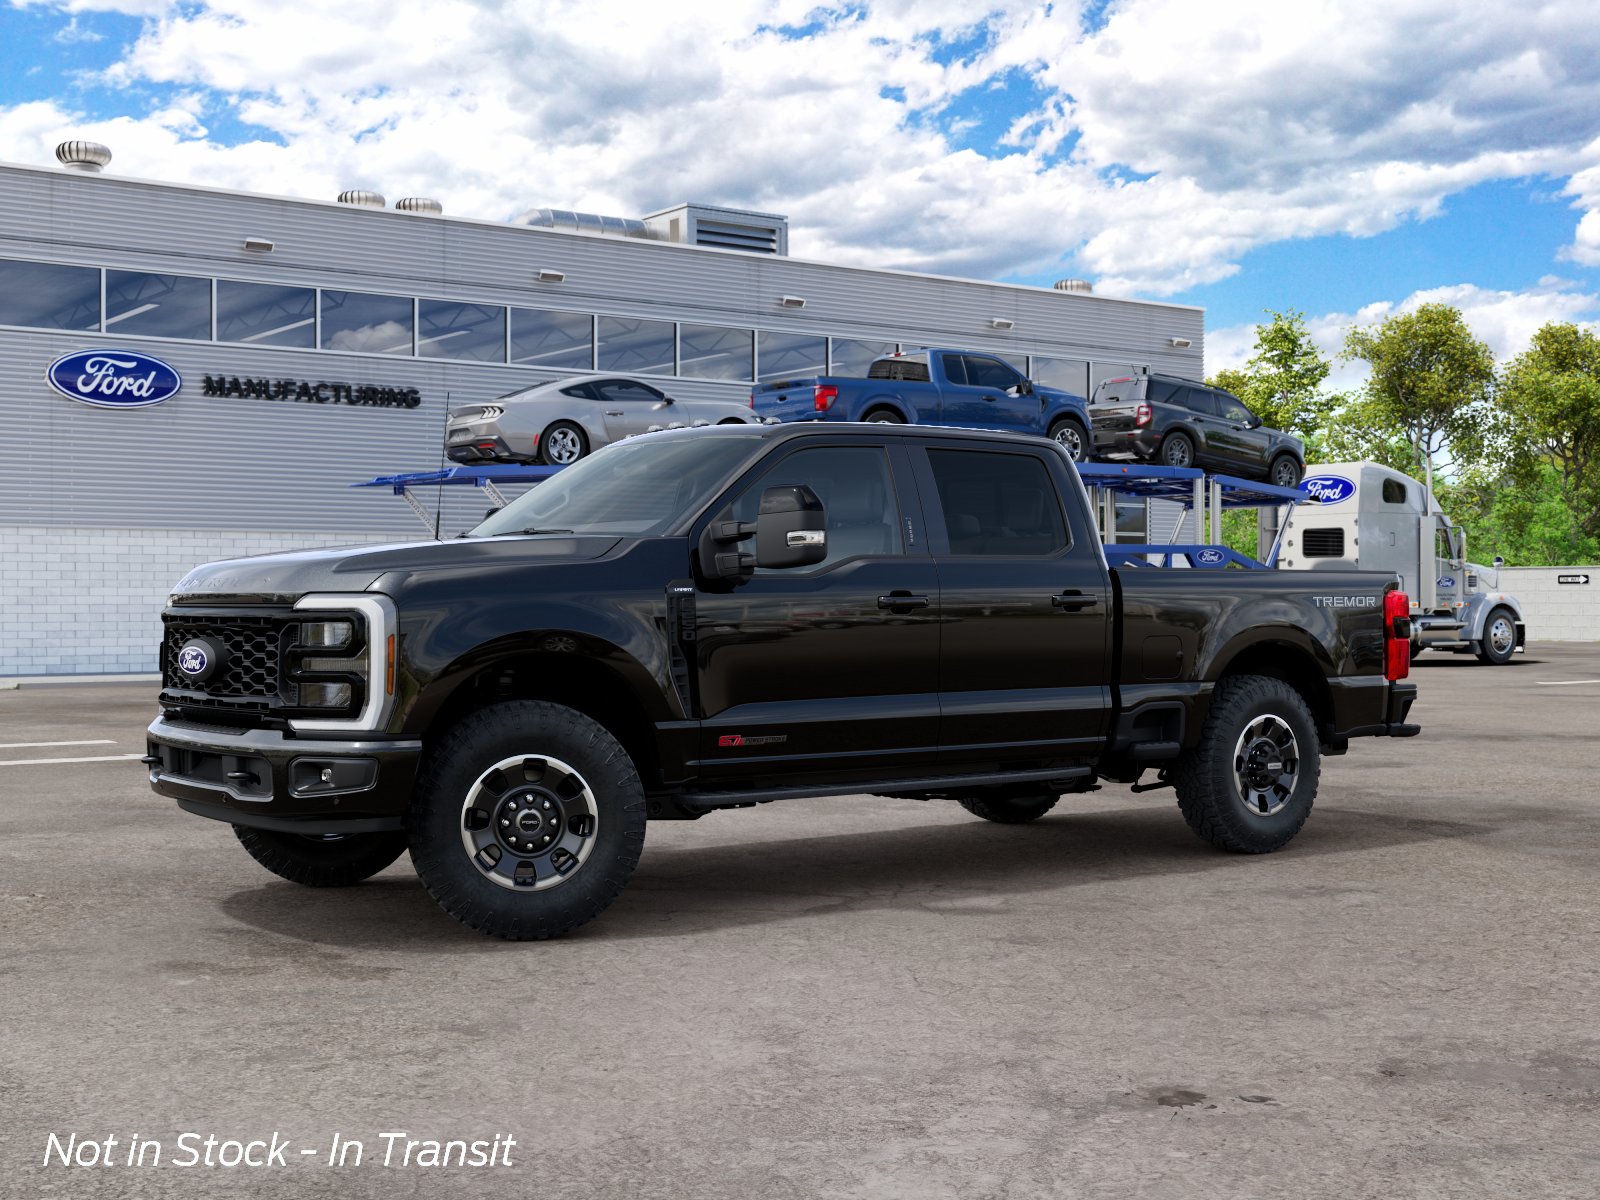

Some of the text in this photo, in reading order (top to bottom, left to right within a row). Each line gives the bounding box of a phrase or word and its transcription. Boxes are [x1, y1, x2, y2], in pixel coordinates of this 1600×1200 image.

[77, 357, 157, 397] Ford
[202, 374, 421, 408] MANUFACTURING
[1305, 479, 1343, 500] Ford
[1201, 550, 1220, 562] Ford
[1312, 595, 1377, 608] TREMOR
[183, 650, 202, 670] Ford
